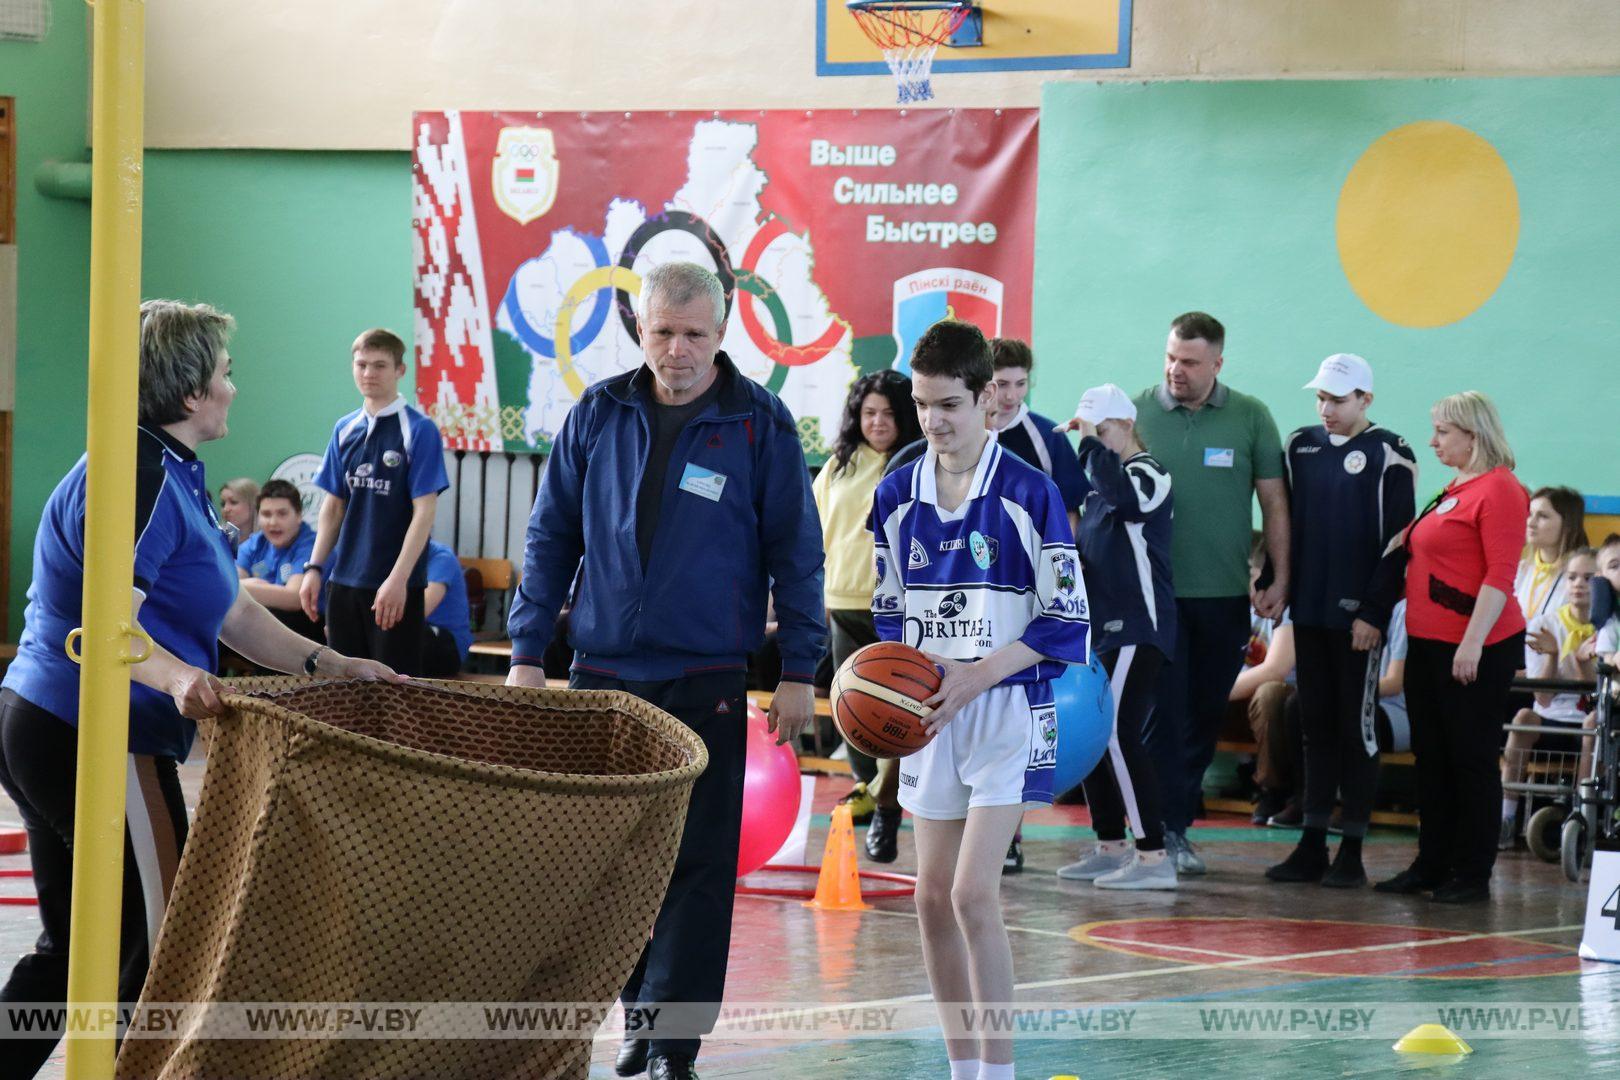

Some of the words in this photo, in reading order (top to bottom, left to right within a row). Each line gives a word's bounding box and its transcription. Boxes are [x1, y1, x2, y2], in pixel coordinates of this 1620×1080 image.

[810, 139, 896, 166] Выше
[833, 176, 958, 205] Сильнее
[866, 215, 997, 249] Быстрее
[954, 276, 988, 295] раён
[924, 609, 937, 619] The
[882, 721, 909, 741] FIBA
[1601, 883, 1620, 931] 4
